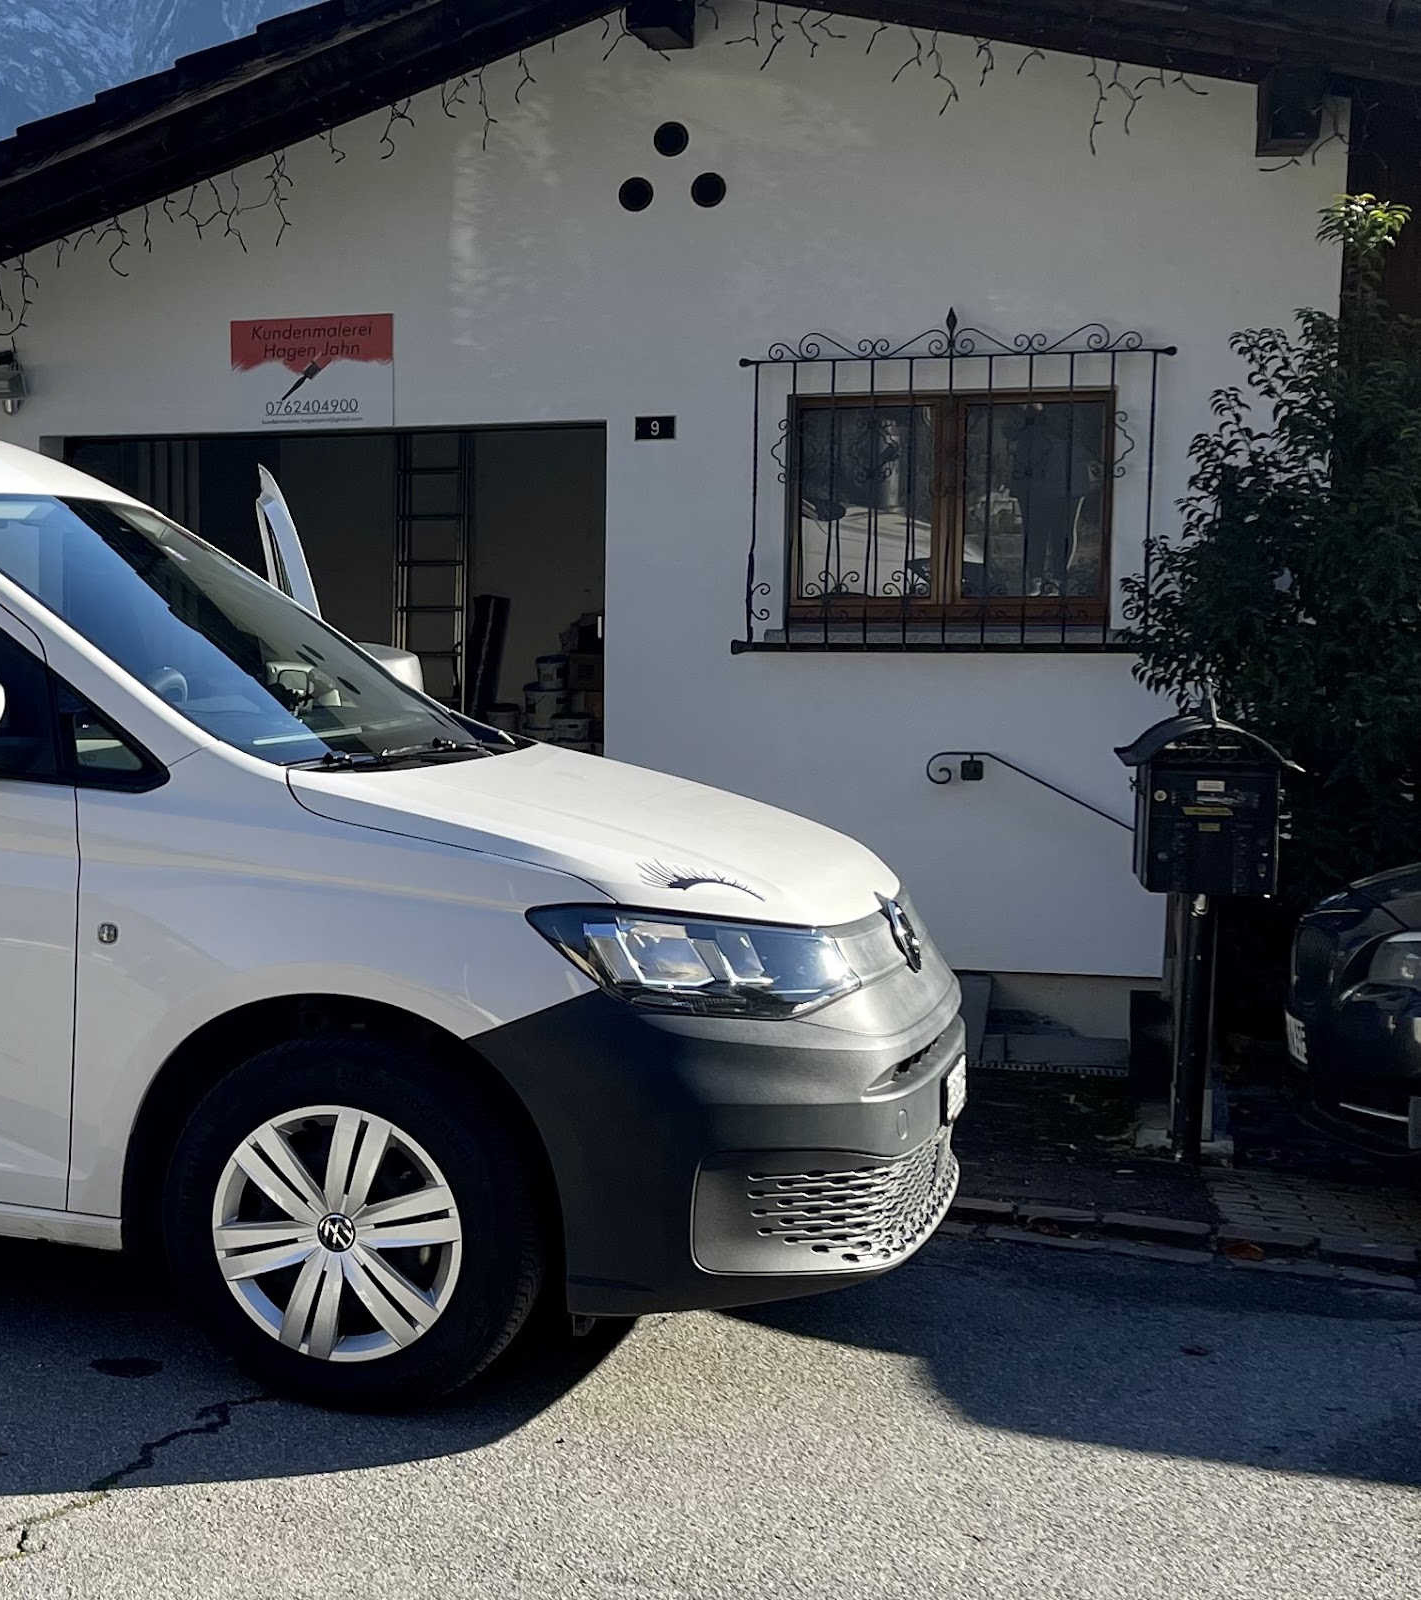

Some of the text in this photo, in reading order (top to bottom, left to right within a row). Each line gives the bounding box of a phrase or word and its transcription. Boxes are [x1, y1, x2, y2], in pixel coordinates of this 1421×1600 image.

[251, 321, 372, 341] Kundenmalerei
[263, 340, 360, 361] Hagen Jahn
[265, 398, 359, 415] 0762404900
[650, 420, 660, 436] 9
